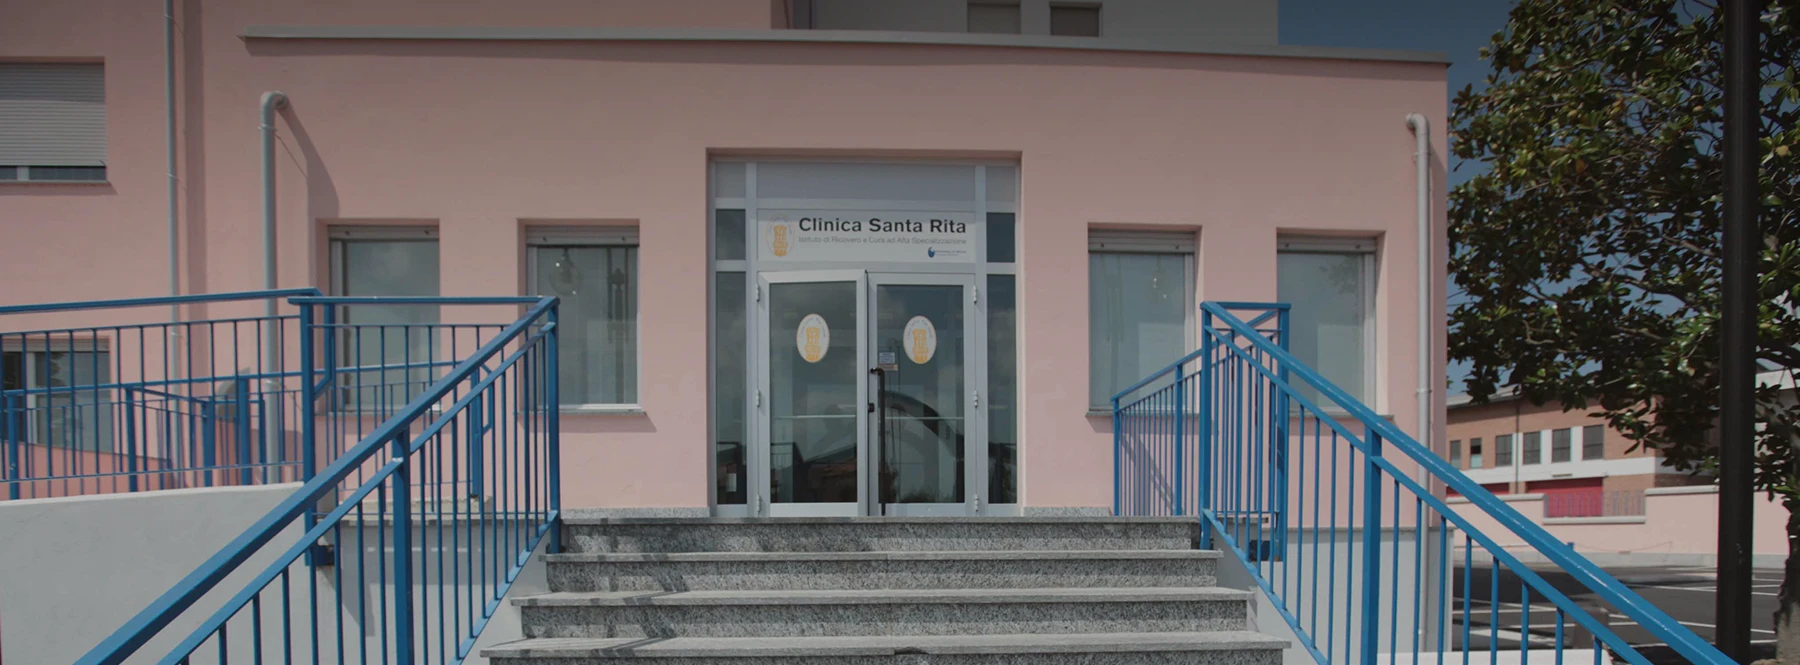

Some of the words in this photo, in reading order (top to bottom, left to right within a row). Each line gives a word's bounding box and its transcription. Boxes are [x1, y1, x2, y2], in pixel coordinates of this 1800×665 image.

[799, 217, 862, 232] Clinica
[869, 218, 923, 233] Santa
[930, 219, 966, 234] Rita
[869, 236, 885, 244] Cura
[911, 237, 966, 245] Specializzazione
